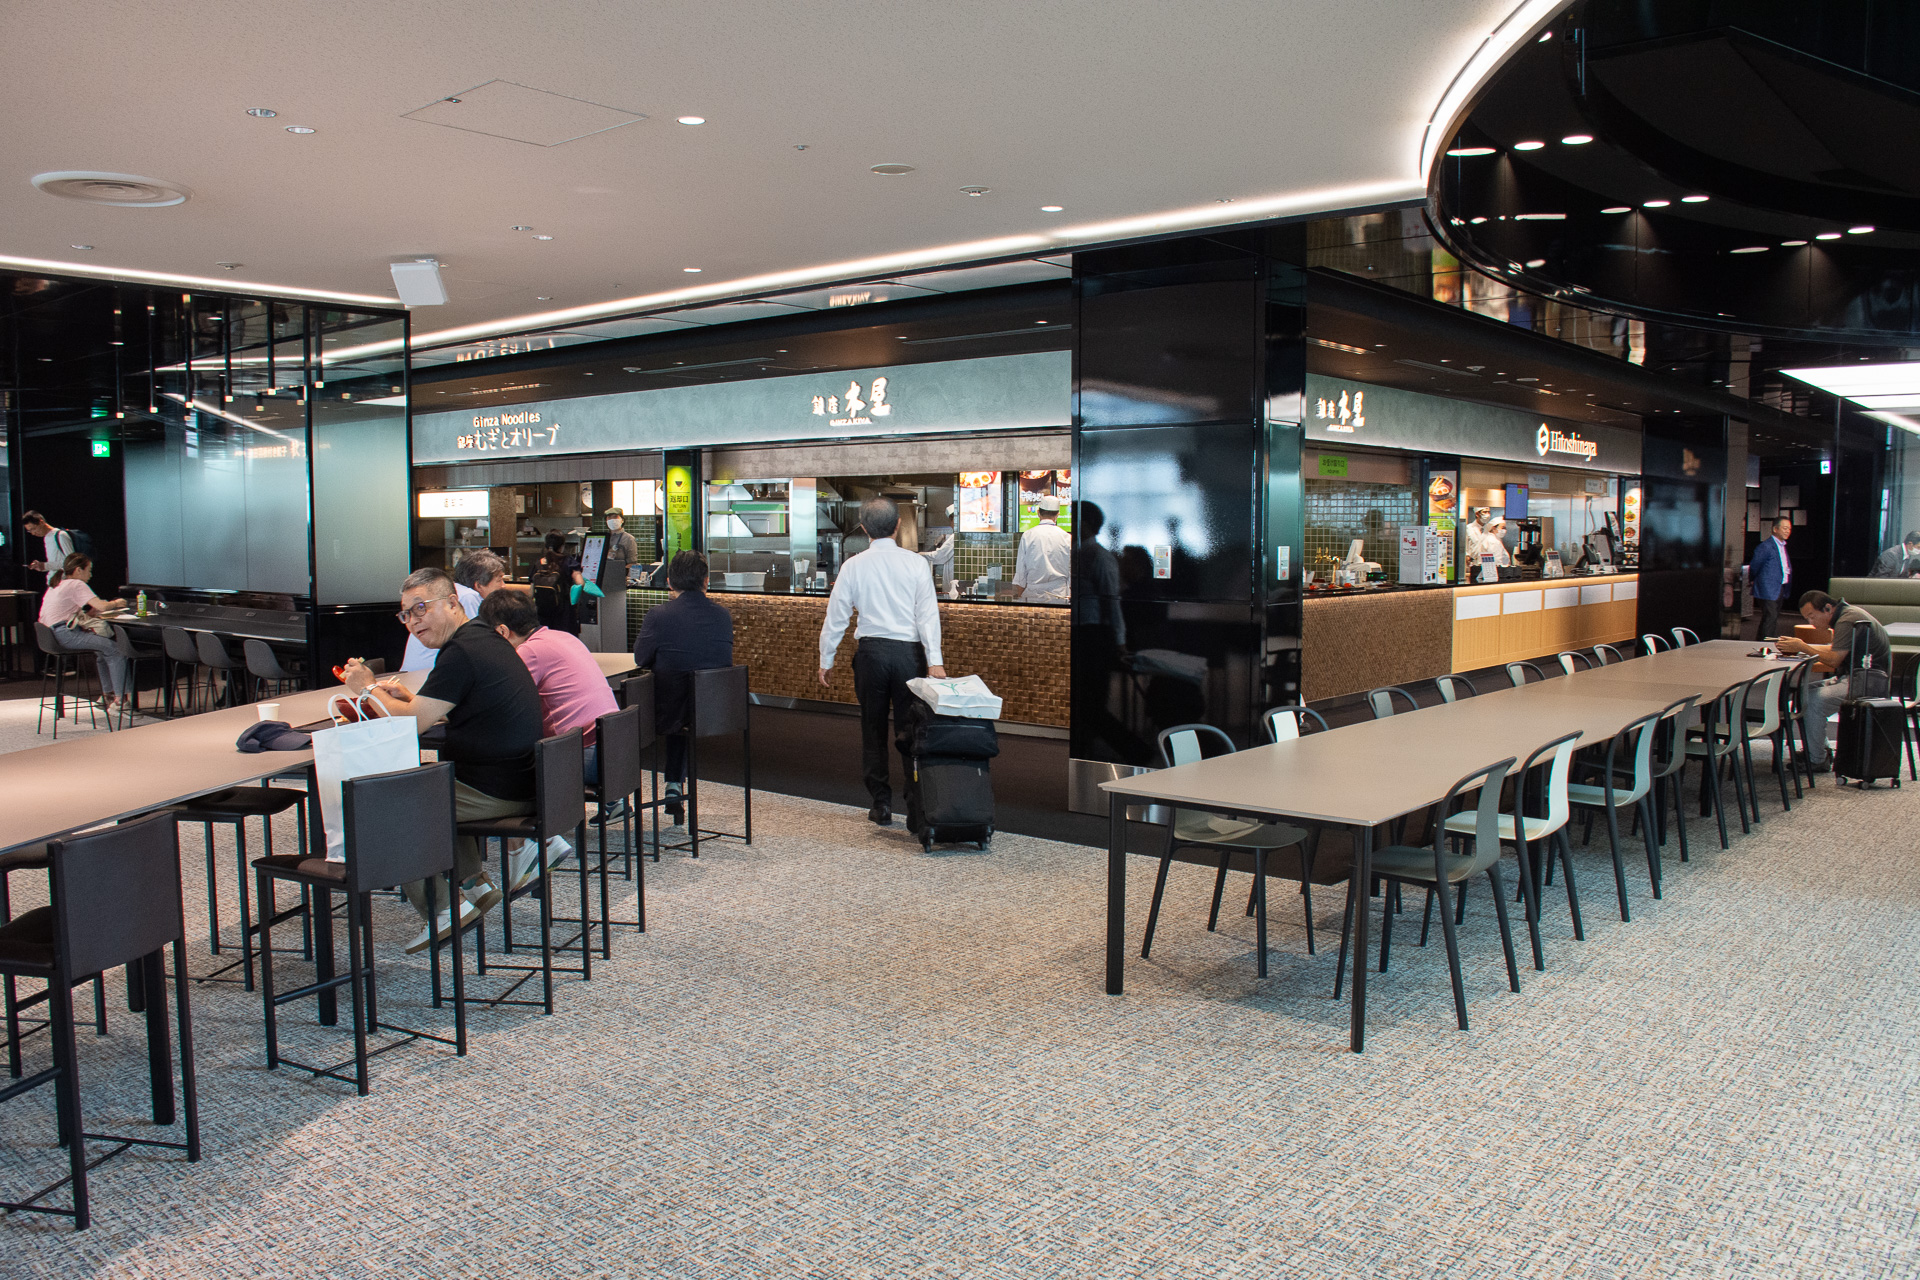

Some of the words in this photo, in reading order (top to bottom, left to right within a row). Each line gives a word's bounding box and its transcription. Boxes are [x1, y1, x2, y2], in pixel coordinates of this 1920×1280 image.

[473, 416, 500, 428] Ginza
[501, 411, 541, 425] Noodles
[1549, 430, 1598, 462] Hitoshinaya
